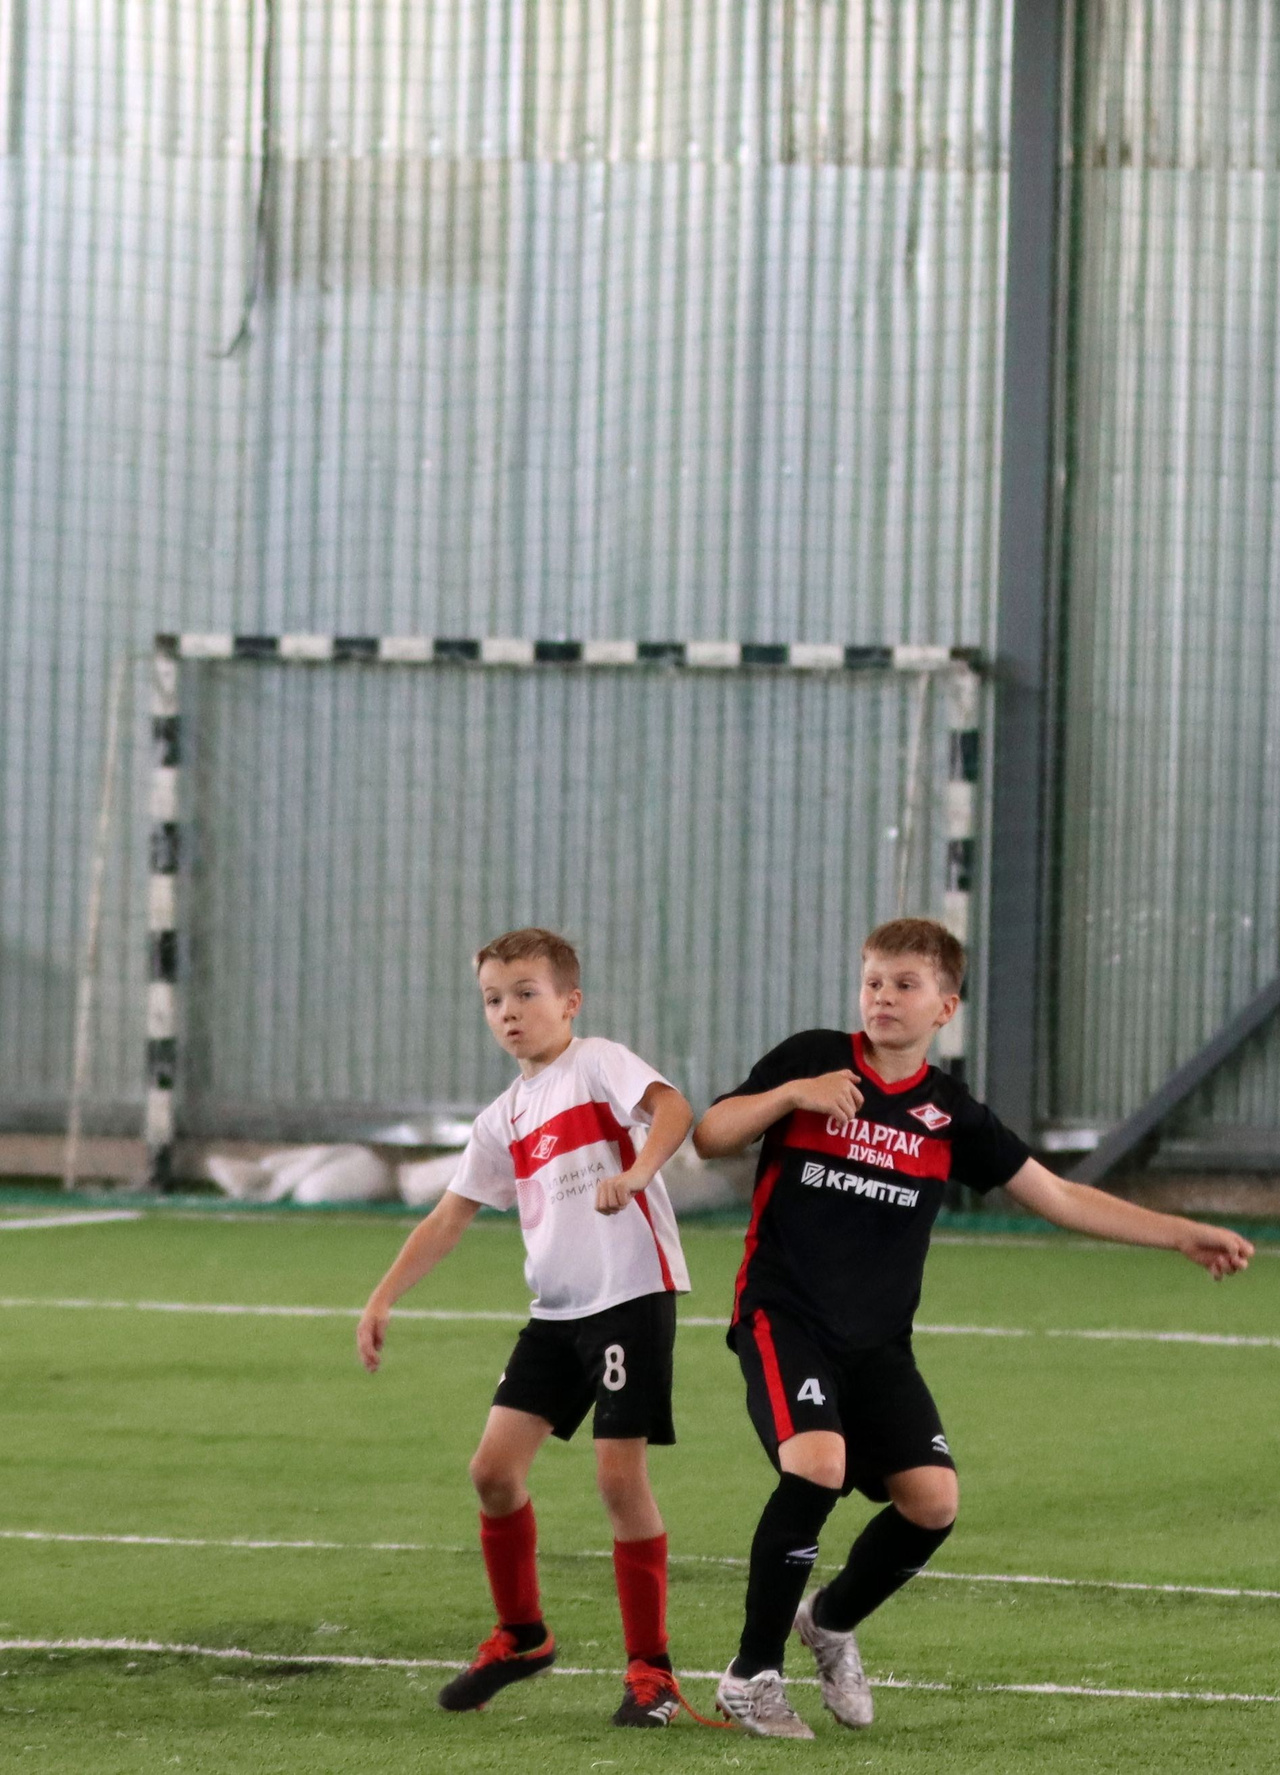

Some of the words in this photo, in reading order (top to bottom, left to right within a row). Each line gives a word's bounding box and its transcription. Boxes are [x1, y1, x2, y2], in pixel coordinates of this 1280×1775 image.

[826, 1114, 924, 1158] СПАРТАК
[847, 1143, 894, 1169] ДУБНА
[826, 1169, 920, 1207] КРИПТЕН
[603, 1344, 626, 1391] 8
[797, 1378, 826, 1406] 4
